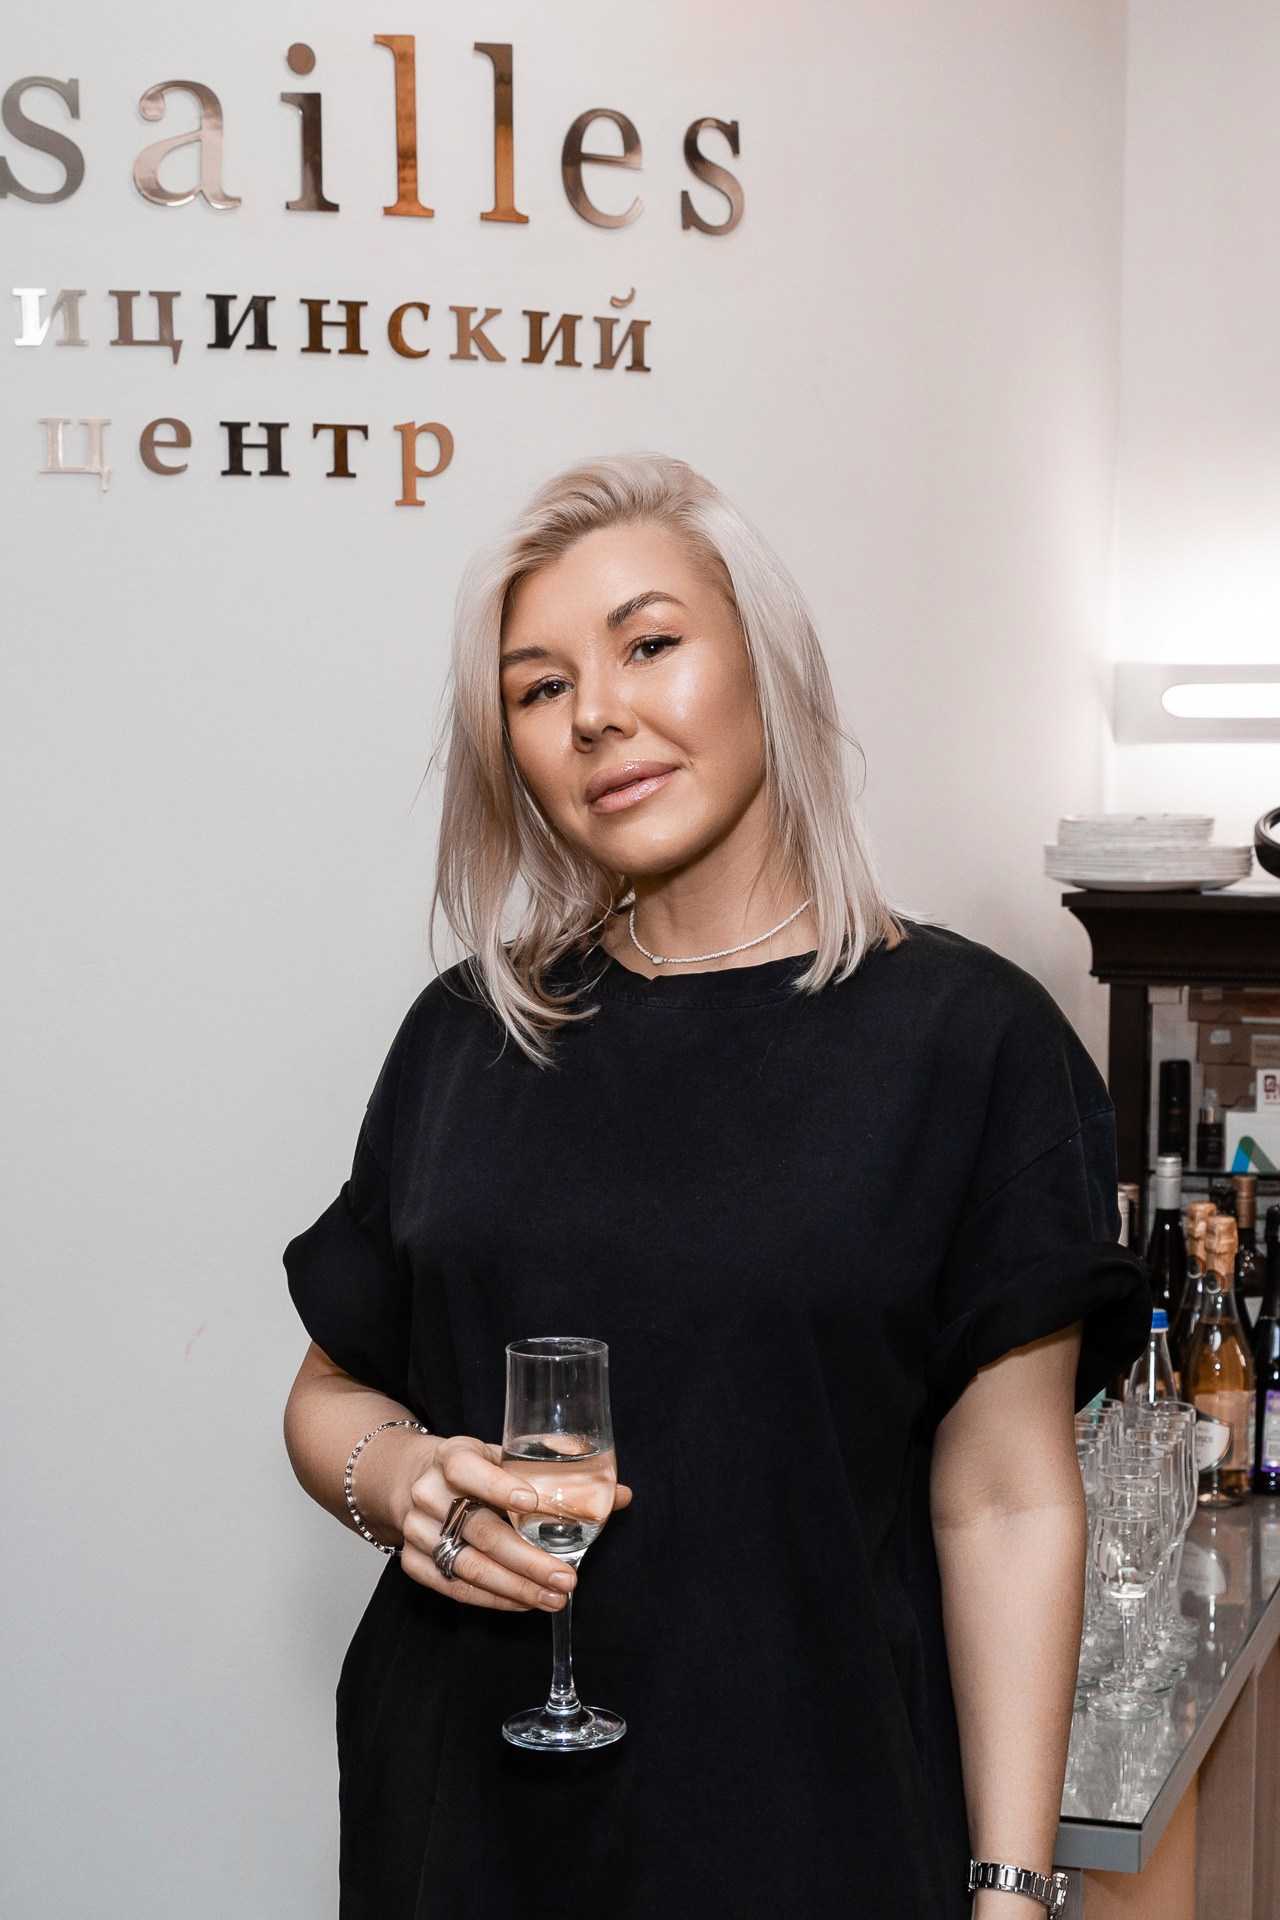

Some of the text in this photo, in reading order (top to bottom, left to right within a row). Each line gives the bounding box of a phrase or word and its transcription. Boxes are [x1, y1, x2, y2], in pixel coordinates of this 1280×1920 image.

[0, 34, 745, 236] sailles
[12, 287, 652, 373] ицинский
[37, 416, 454, 506] центр
